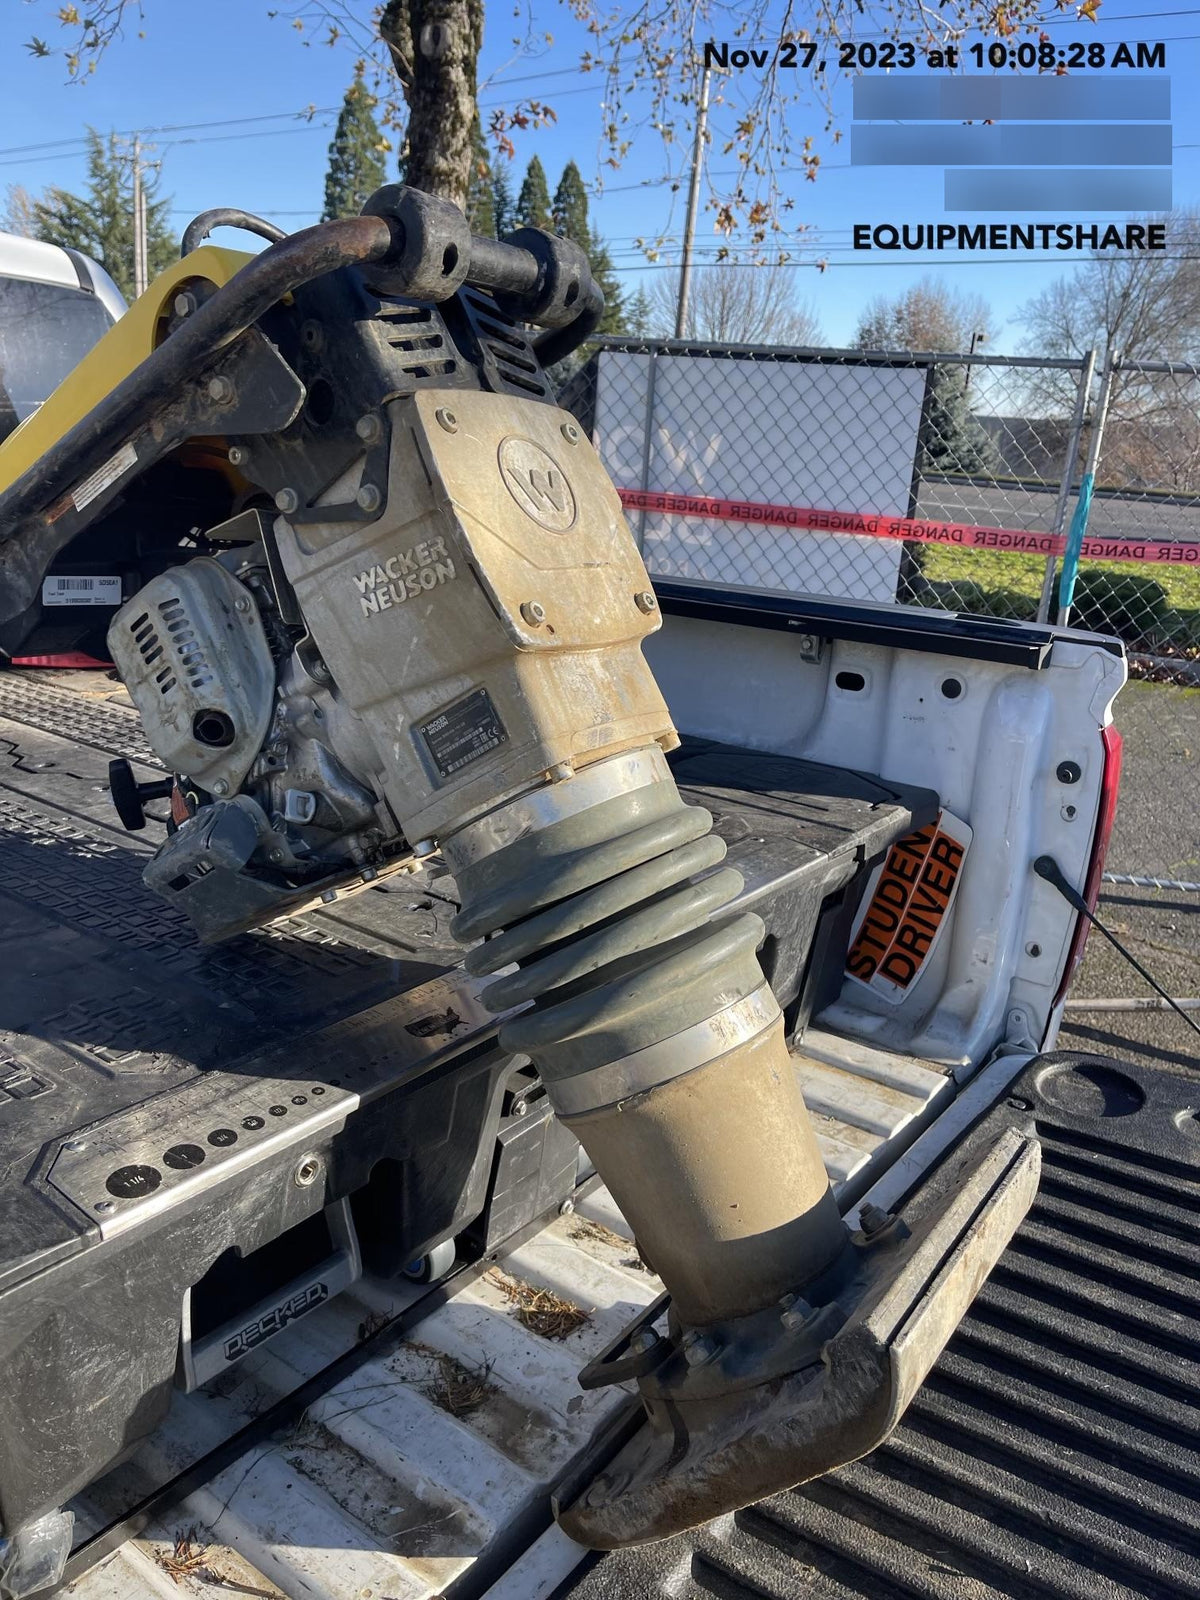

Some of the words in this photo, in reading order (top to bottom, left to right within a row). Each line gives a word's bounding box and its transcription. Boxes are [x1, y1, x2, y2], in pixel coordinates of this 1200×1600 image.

[352, 536, 449, 594] WACKER
[360, 558, 456, 617] NEUSON
[846, 812, 942, 981] STUDEN
[880, 836, 965, 987] DRIVER
[223, 1281, 329, 1361] DECKED
